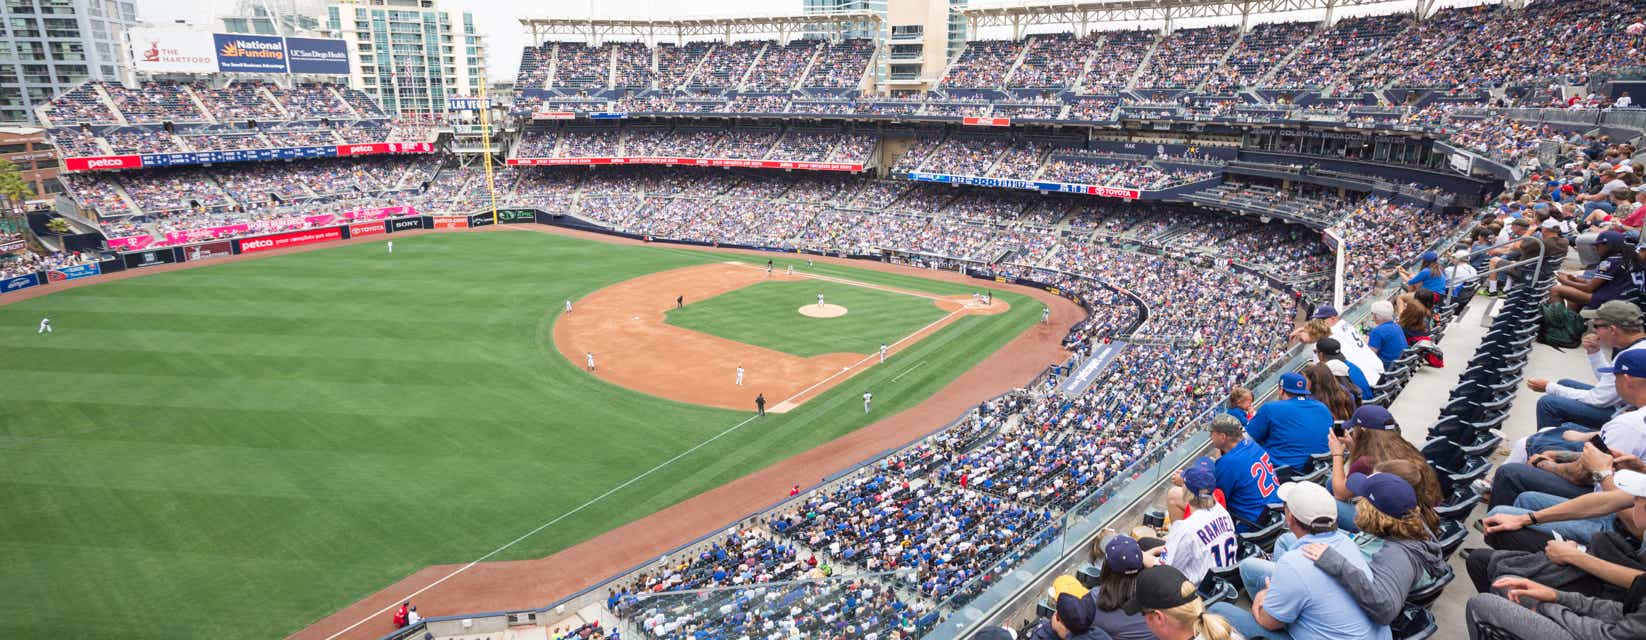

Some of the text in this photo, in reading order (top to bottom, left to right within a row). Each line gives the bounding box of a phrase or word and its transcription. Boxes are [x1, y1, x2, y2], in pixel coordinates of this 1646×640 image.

[236, 40, 282, 50] National
[238, 48, 283, 60] Funding
[451, 100, 465, 109] LAS
[350, 145, 373, 154] petco
[87, 158, 123, 169] petco
[1105, 189, 1131, 197] TOYOTA
[360, 225, 384, 233] TOYOTA
[396, 220, 419, 228] SONY
[242, 239, 274, 250] petco
[1251, 453, 1280, 498] 25
[1210, 536, 1237, 568] 16
